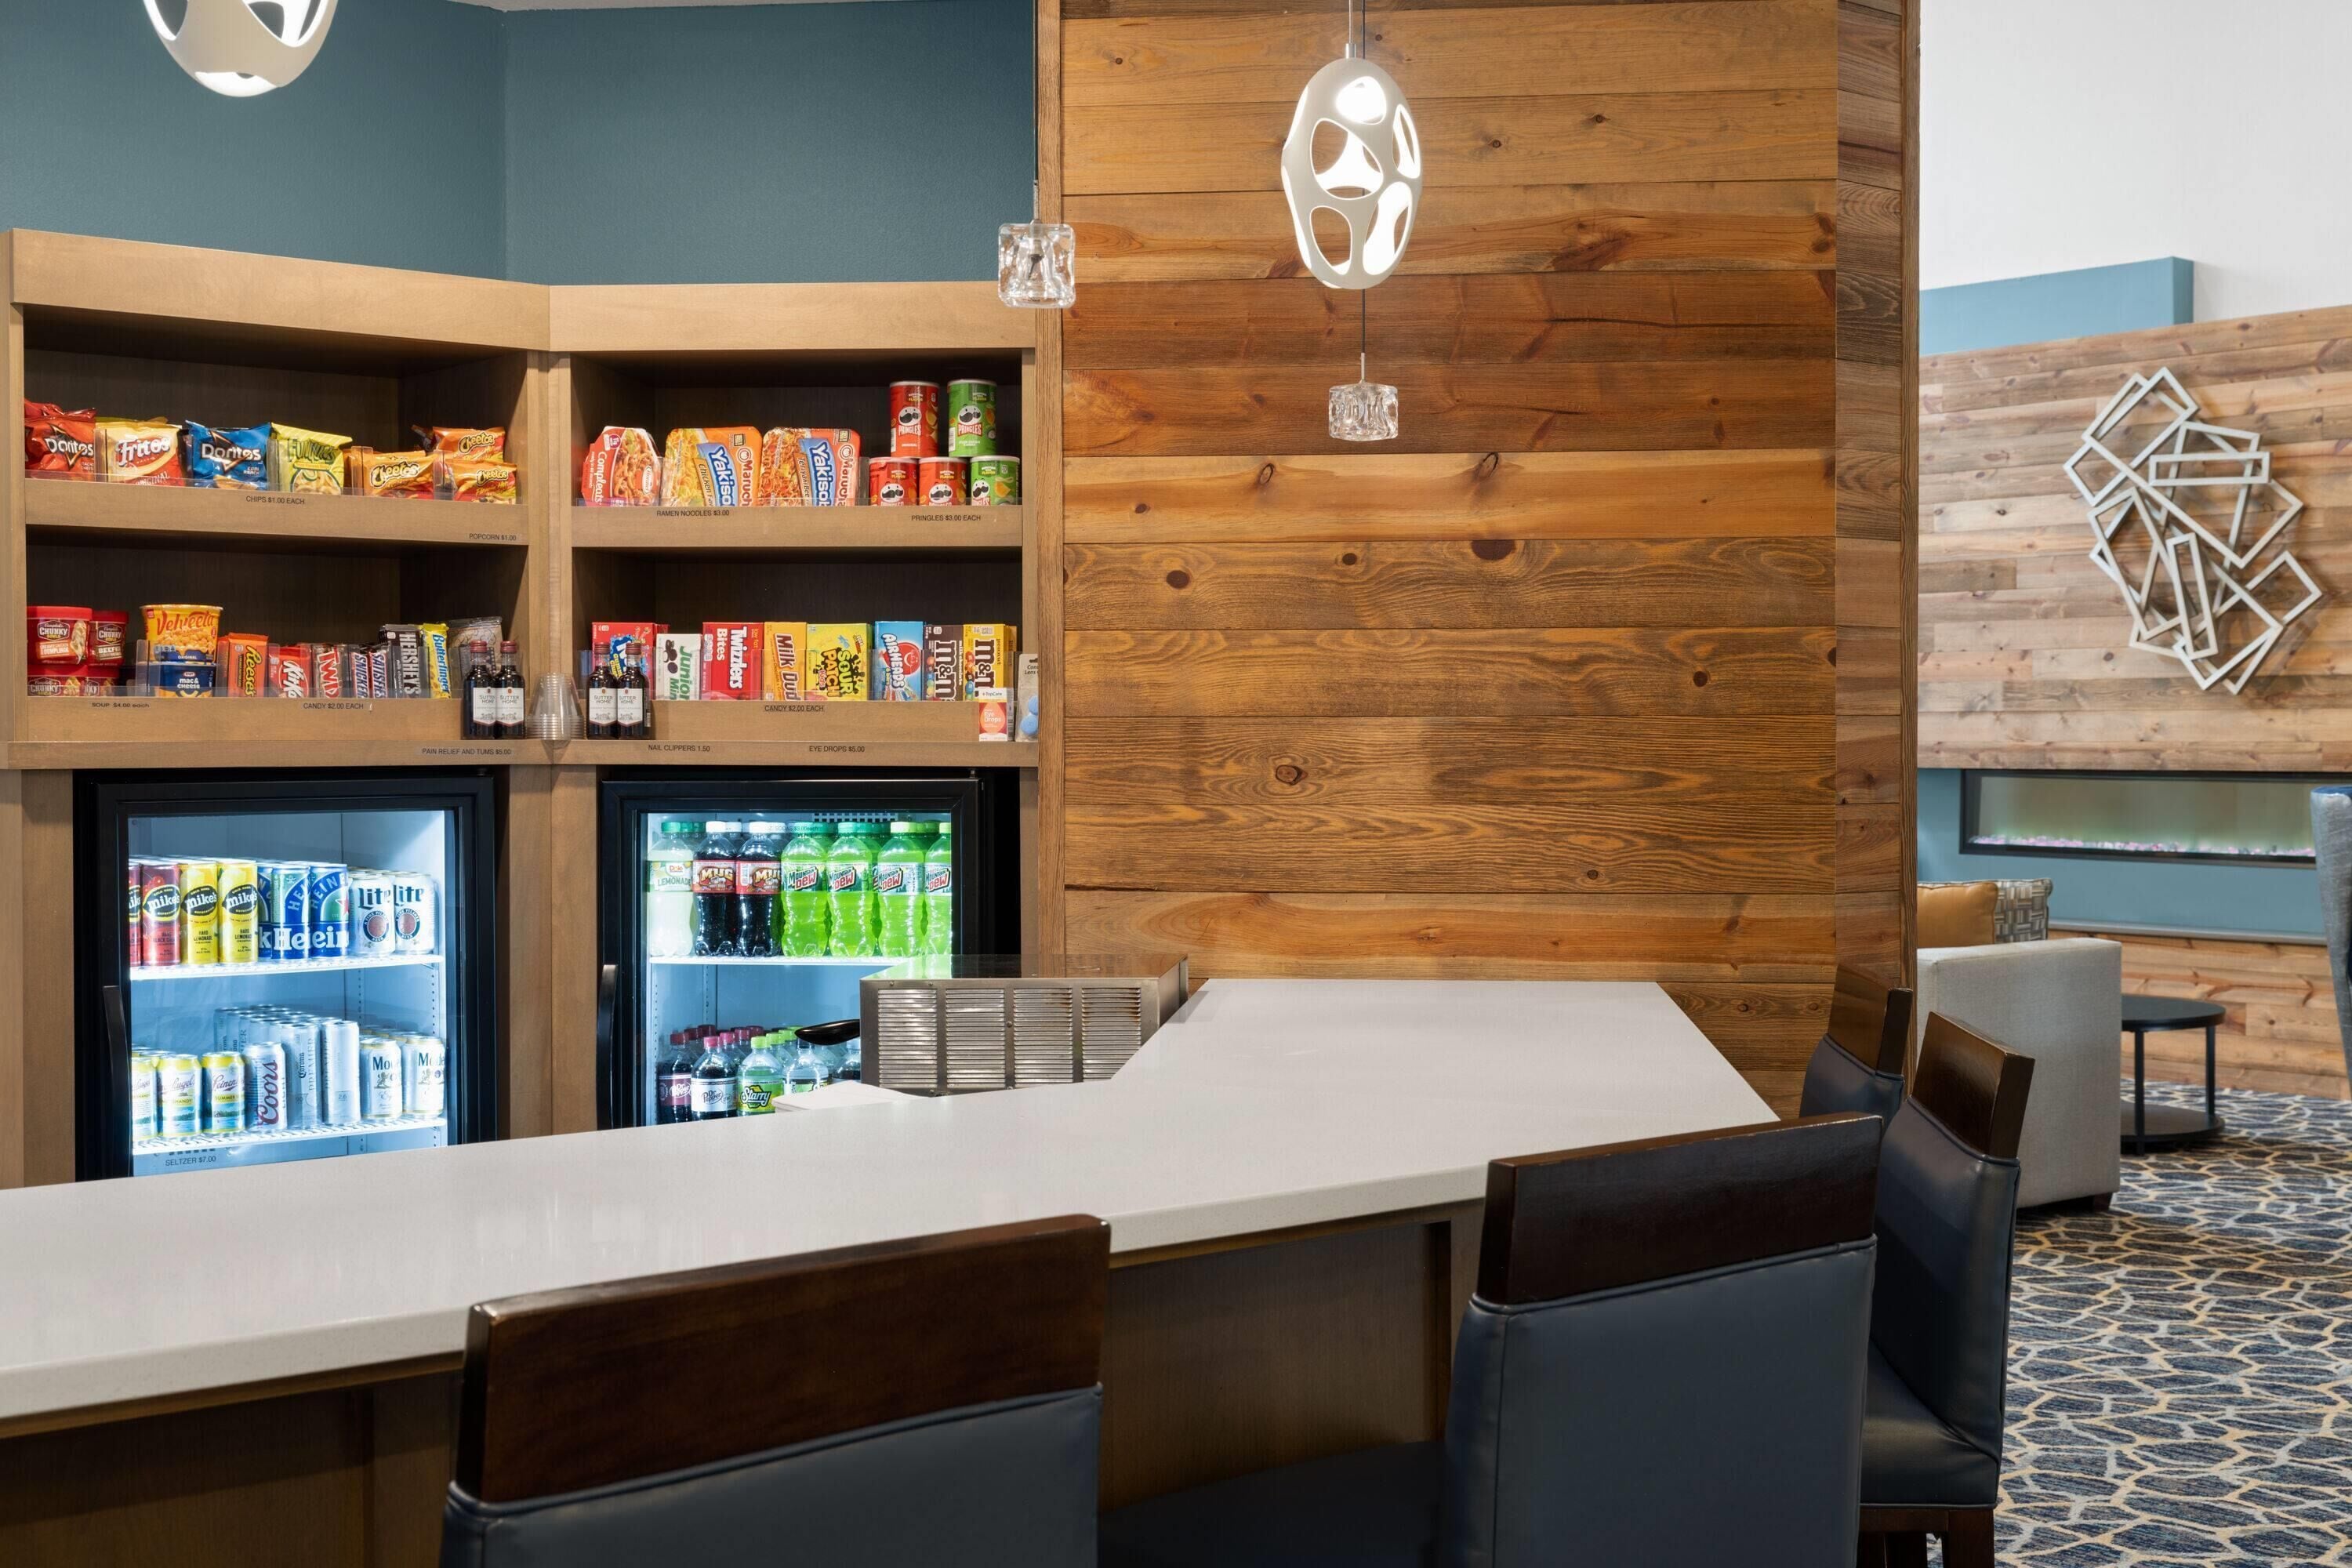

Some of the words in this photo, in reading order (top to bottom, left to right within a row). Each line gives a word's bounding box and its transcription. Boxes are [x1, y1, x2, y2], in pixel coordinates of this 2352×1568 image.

[898, 425, 921, 436] PRINGLES
[958, 424, 982, 436] PRINGLES
[45, 438, 93, 456] Doritos
[114, 437, 171, 466] Fritos
[201, 443, 262, 461] Doritos
[459, 432, 495, 454] Cheetos
[371, 460, 419, 489] Cheetos
[476, 468, 509, 486] Cheetos
[593, 452, 608, 503] Compleats
[709, 445, 735, 506] Yakiso
[39, 626, 67, 635] CHUNKY
[157, 610, 215, 636] Velveeta
[98, 630, 122, 639] CHUNKY
[717, 627, 728, 661] Bites
[729, 626, 748, 689] Twizzlers
[775, 633, 796, 668] Milk
[881, 633, 906, 688] AIRHEADS
[245, 645, 262, 696] Reese's
[399, 633, 421, 695] HERSHEY'S
[432, 633, 450, 693] Butterfinger
[821, 648, 842, 697] PATCH
[837, 649, 855, 695] SOUR
[658, 877, 691, 886] LEMONADE
[701, 868, 734, 881] MUG
[147, 892, 180, 910] mike's
[185, 891, 217, 909] mike's
[226, 889, 258, 908] mike's
[257, 1059, 279, 1126] Coors
[702, 1092, 721, 1103] Pepper
[742, 1087, 771, 1106] Starry
[165, 1156, 197, 1167] SELTZER
[198, 1155, 216, 1163] $7.00
